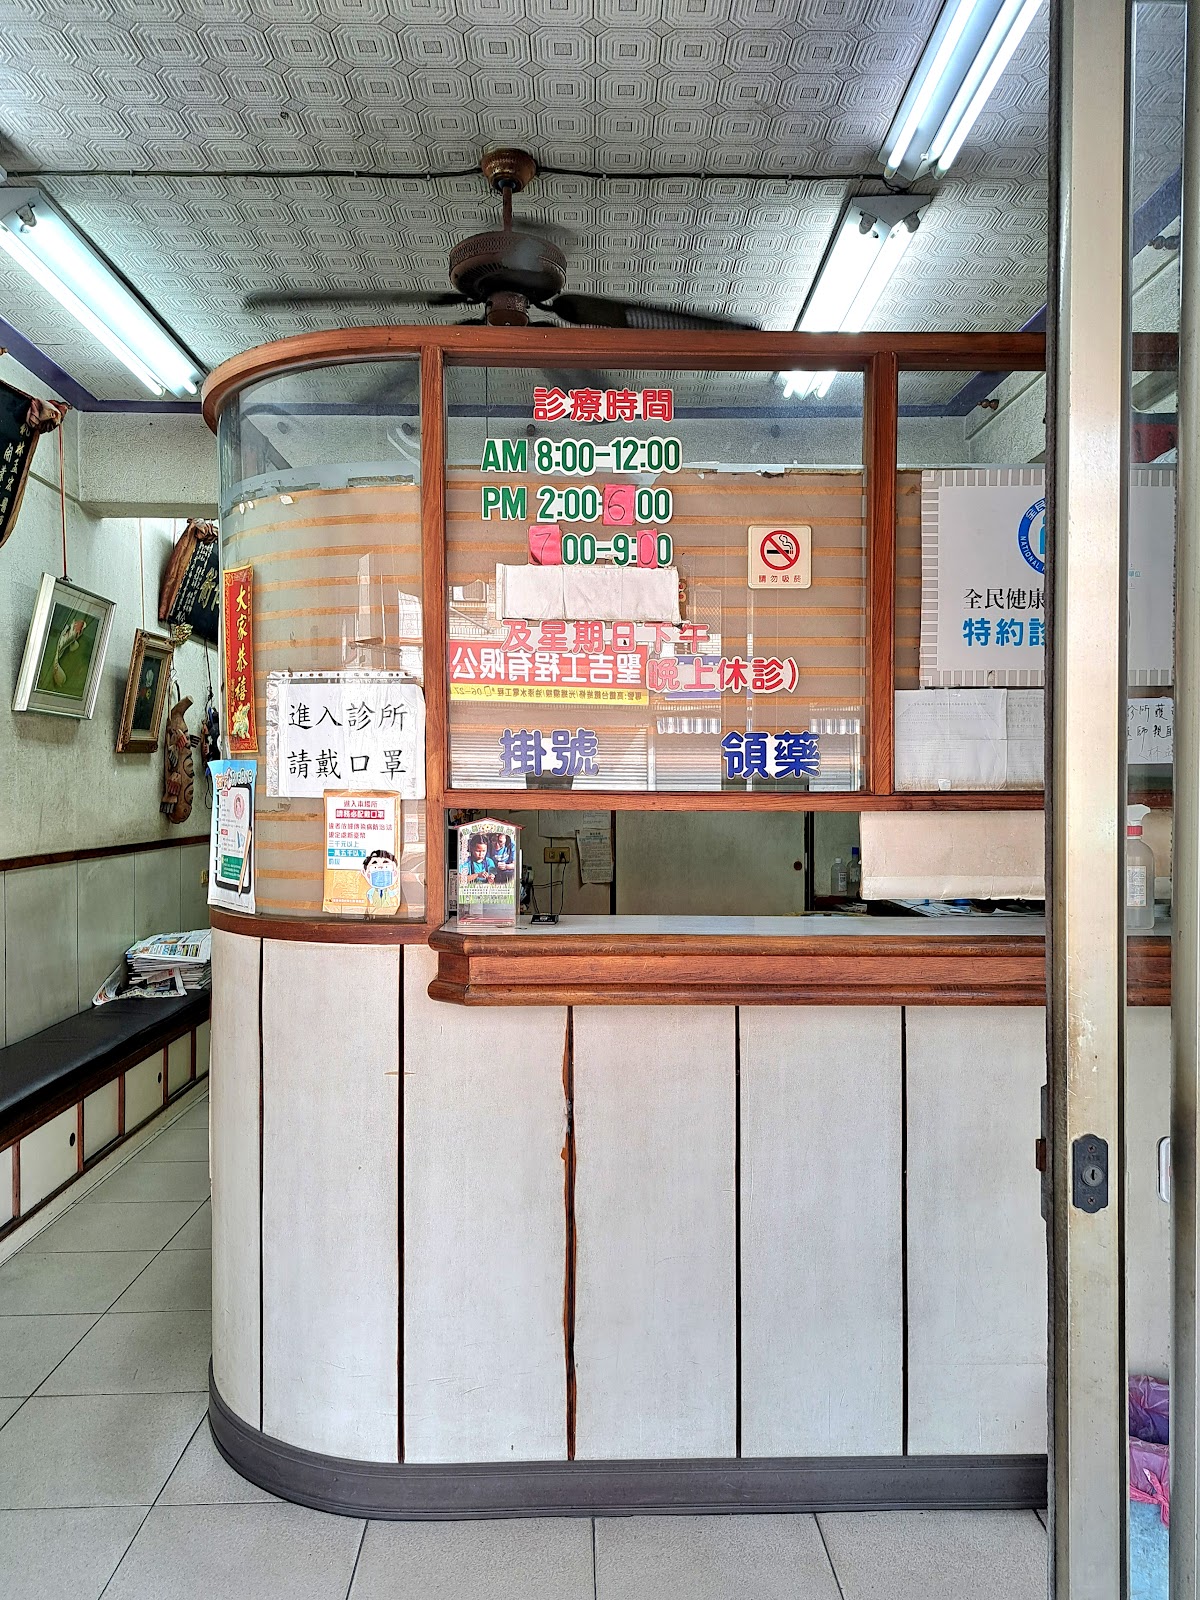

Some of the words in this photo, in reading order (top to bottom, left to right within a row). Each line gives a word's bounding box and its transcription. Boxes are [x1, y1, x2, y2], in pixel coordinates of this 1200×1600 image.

[533, 387, 673, 422] 診療時間
[481, 439, 528, 472] AM
[536, 438, 681, 473] 8:00-12:00
[482, 486, 528, 519] PM
[1020, 535, 1040, 569] NATIONAL
[963, 587, 1047, 610] 全民健康
[501, 619, 711, 655] 及星期日下午
[287, 700, 408, 732] 進入診所
[286, 748, 407, 781] 請戴口罩
[498, 728, 600, 777] 掛號
[720, 731, 820, 779] 領藥
